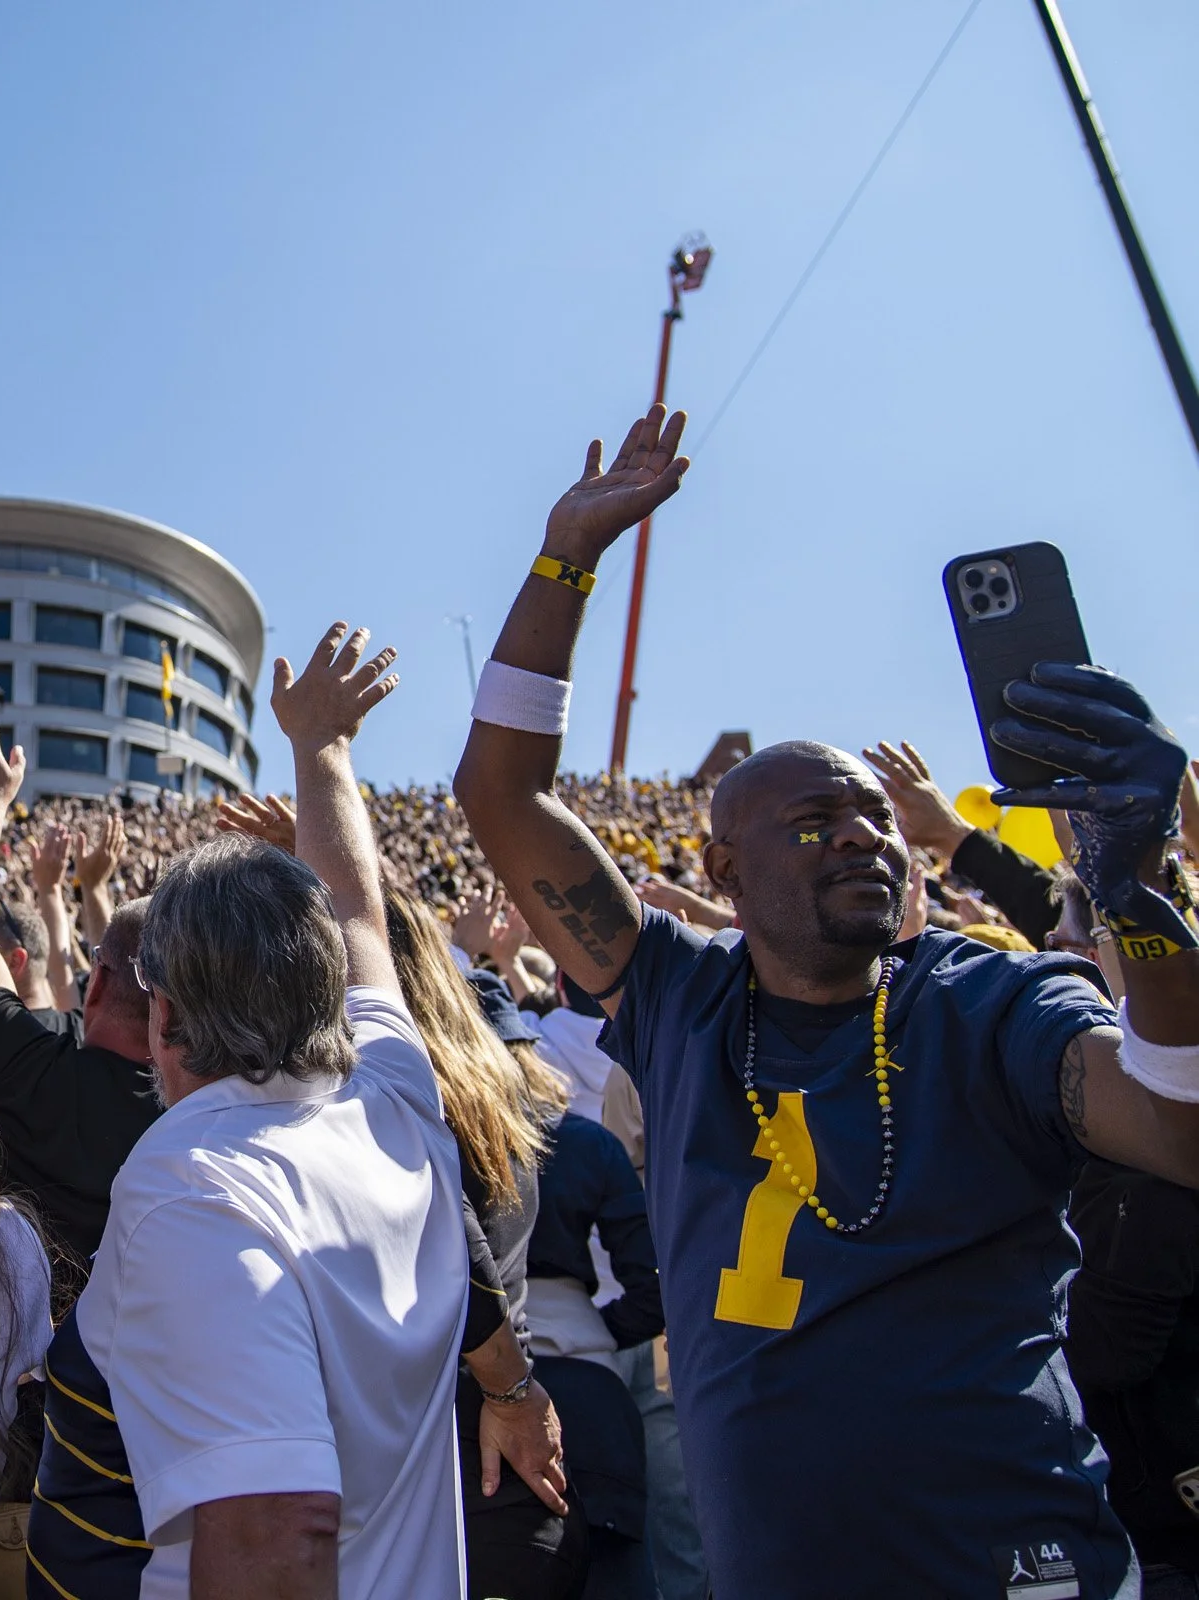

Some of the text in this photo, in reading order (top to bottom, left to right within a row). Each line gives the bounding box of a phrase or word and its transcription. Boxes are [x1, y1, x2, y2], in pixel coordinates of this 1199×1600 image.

[799, 832, 820, 844] M
[532, 880, 613, 968] GO BLUE
[714, 1091, 818, 1330] 1
[1040, 1543, 1064, 1561] 44
